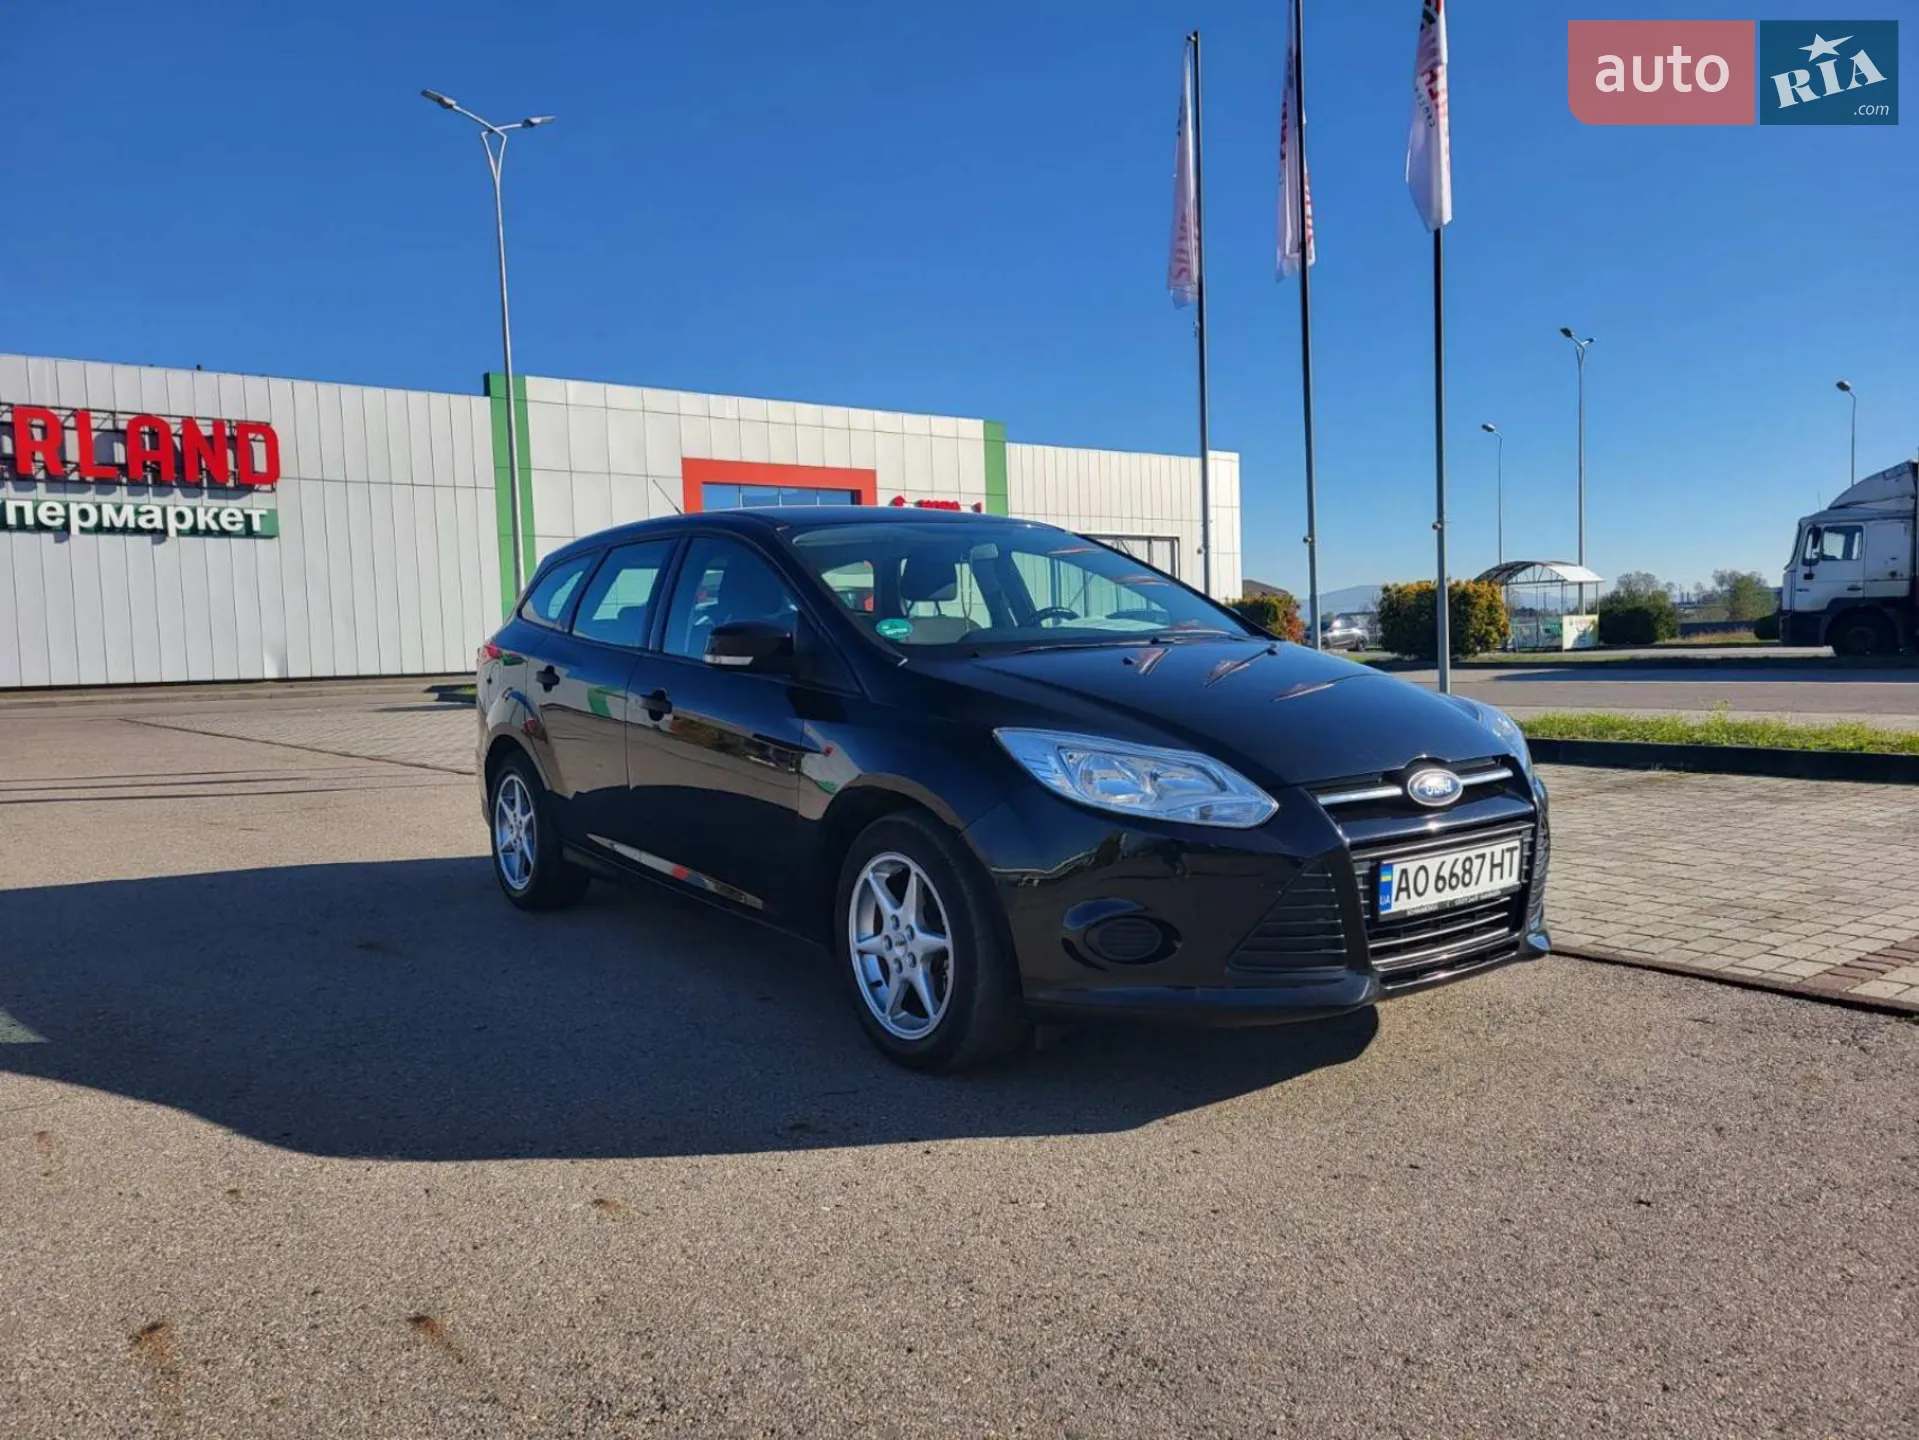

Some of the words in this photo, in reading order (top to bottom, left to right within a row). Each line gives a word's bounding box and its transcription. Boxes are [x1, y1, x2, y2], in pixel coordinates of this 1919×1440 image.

[12, 405, 280, 485] RLAND
[5, 500, 269, 537] пермаркет
[1434, 852, 1487, 894] 6687
